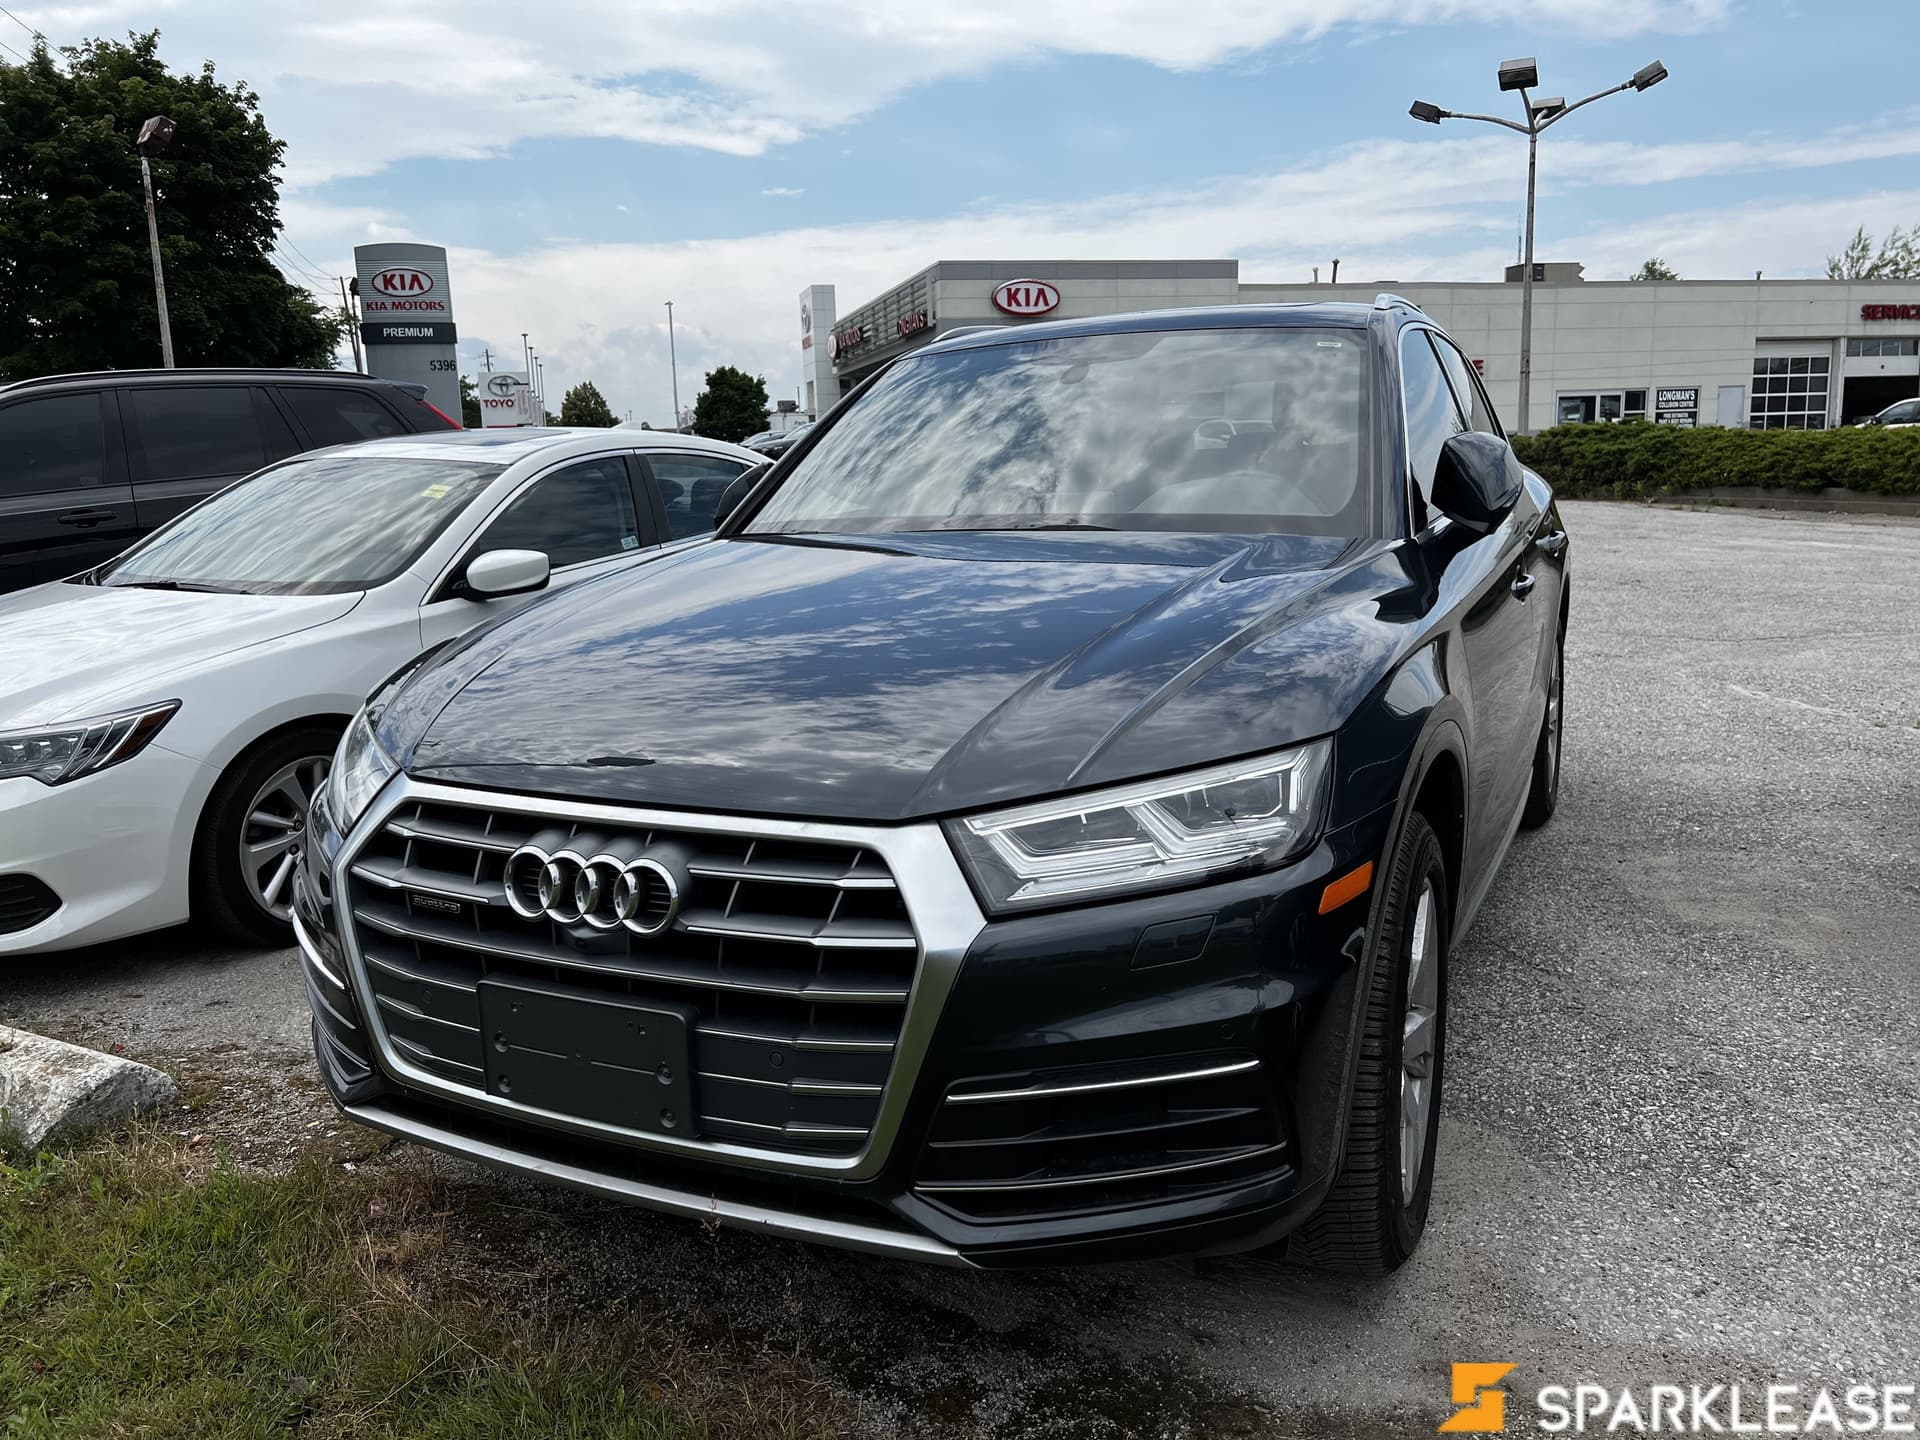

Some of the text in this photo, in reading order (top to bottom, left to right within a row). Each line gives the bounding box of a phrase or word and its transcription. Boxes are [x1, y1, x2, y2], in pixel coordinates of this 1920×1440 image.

[382, 274, 424, 291] KIA
[1006, 287, 1049, 307] KIA
[366, 301, 445, 311] KIA MOTORS
[384, 327, 434, 337] PREMIUM
[430, 360, 456, 371] 5396
[1659, 390, 1695, 401] LONGMAN'S
[483, 399, 514, 408] TOYO
